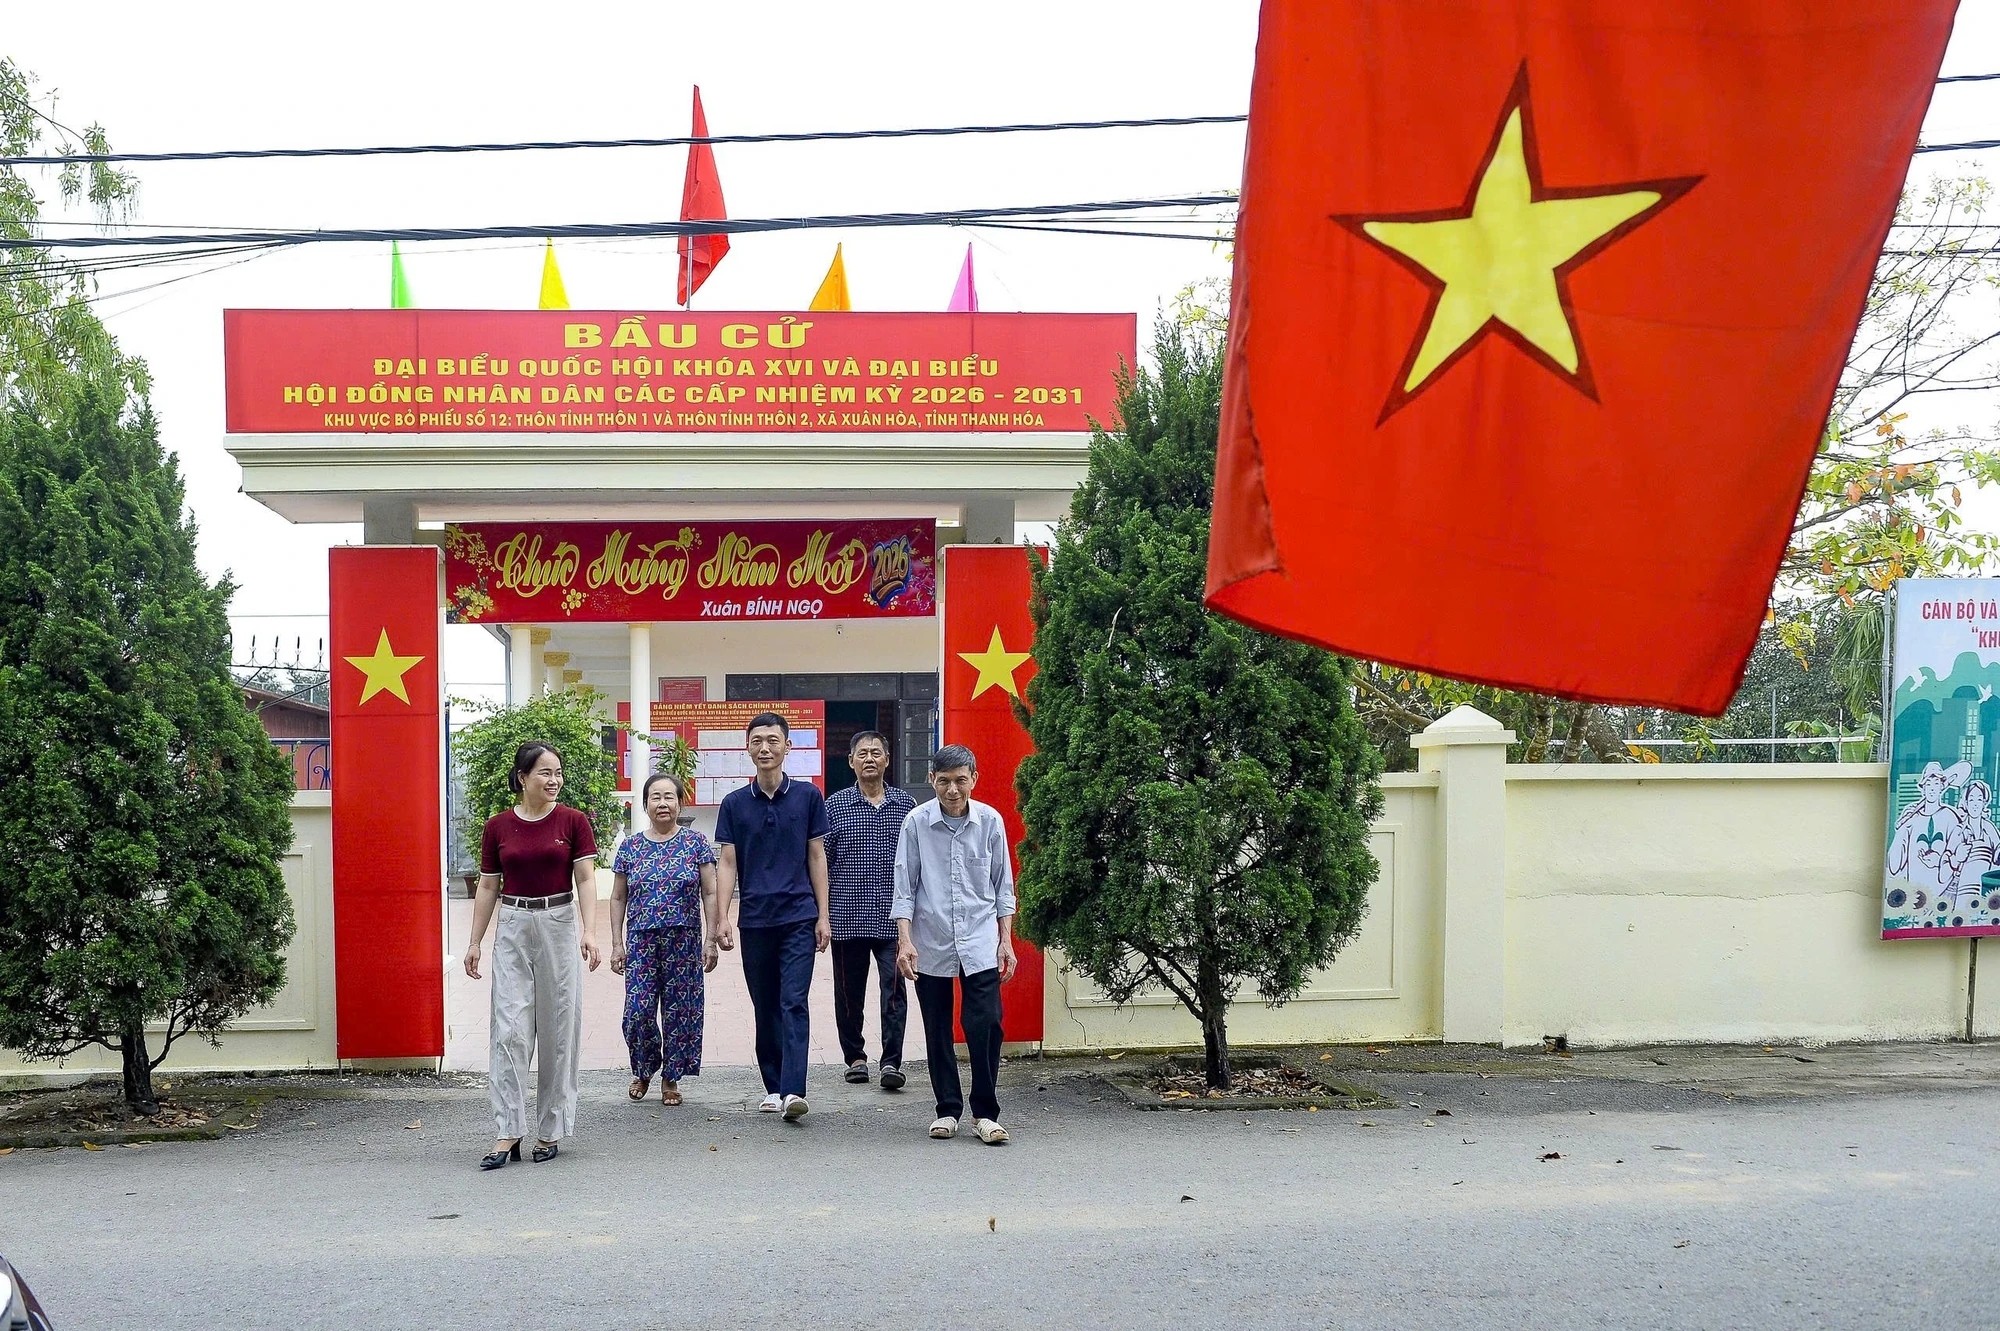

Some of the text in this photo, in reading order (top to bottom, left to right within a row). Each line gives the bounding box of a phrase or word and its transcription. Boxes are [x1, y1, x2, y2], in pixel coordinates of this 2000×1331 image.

[563, 315, 814, 349] BẦU CỬ
[373, 352, 999, 380] ĐẠI BIỂU QUỐC HỘI KHÓA XVI VÀ ĐẠI BIỂU
[283, 382, 337, 407] HỘI
[345, 380, 434, 404] ĐỒNG
[443, 383, 531, 404] NHÂN
[541, 383, 605, 404] DÂN
[614, 382, 677, 404] CÁC
[685, 381, 747, 404] CẤP
[755, 383, 856, 407] NHIỆM
[865, 383, 903, 404] KỲ
[911, 386, 986, 404] 2026
[1013, 386, 1083, 405] 2031
[324, 407, 1045, 430] KHU VỰC BỎ PHIẾU SỐ 12: THÔN TỈNH THÔN 1 VÀ THÔN TỈNH THÔN 2, XÃ XUÂN HÒA, TỈNH THANH HÓA
[494, 529, 868, 600] Chúc Mừng Năm Mới
[872, 536, 909, 591] 2026
[700, 595, 823, 619] Xuân BÍNH NGỌ
[1922, 598, 1998, 623] CÁN BỘ VÀ
[1971, 626, 2000, 648] “KH
